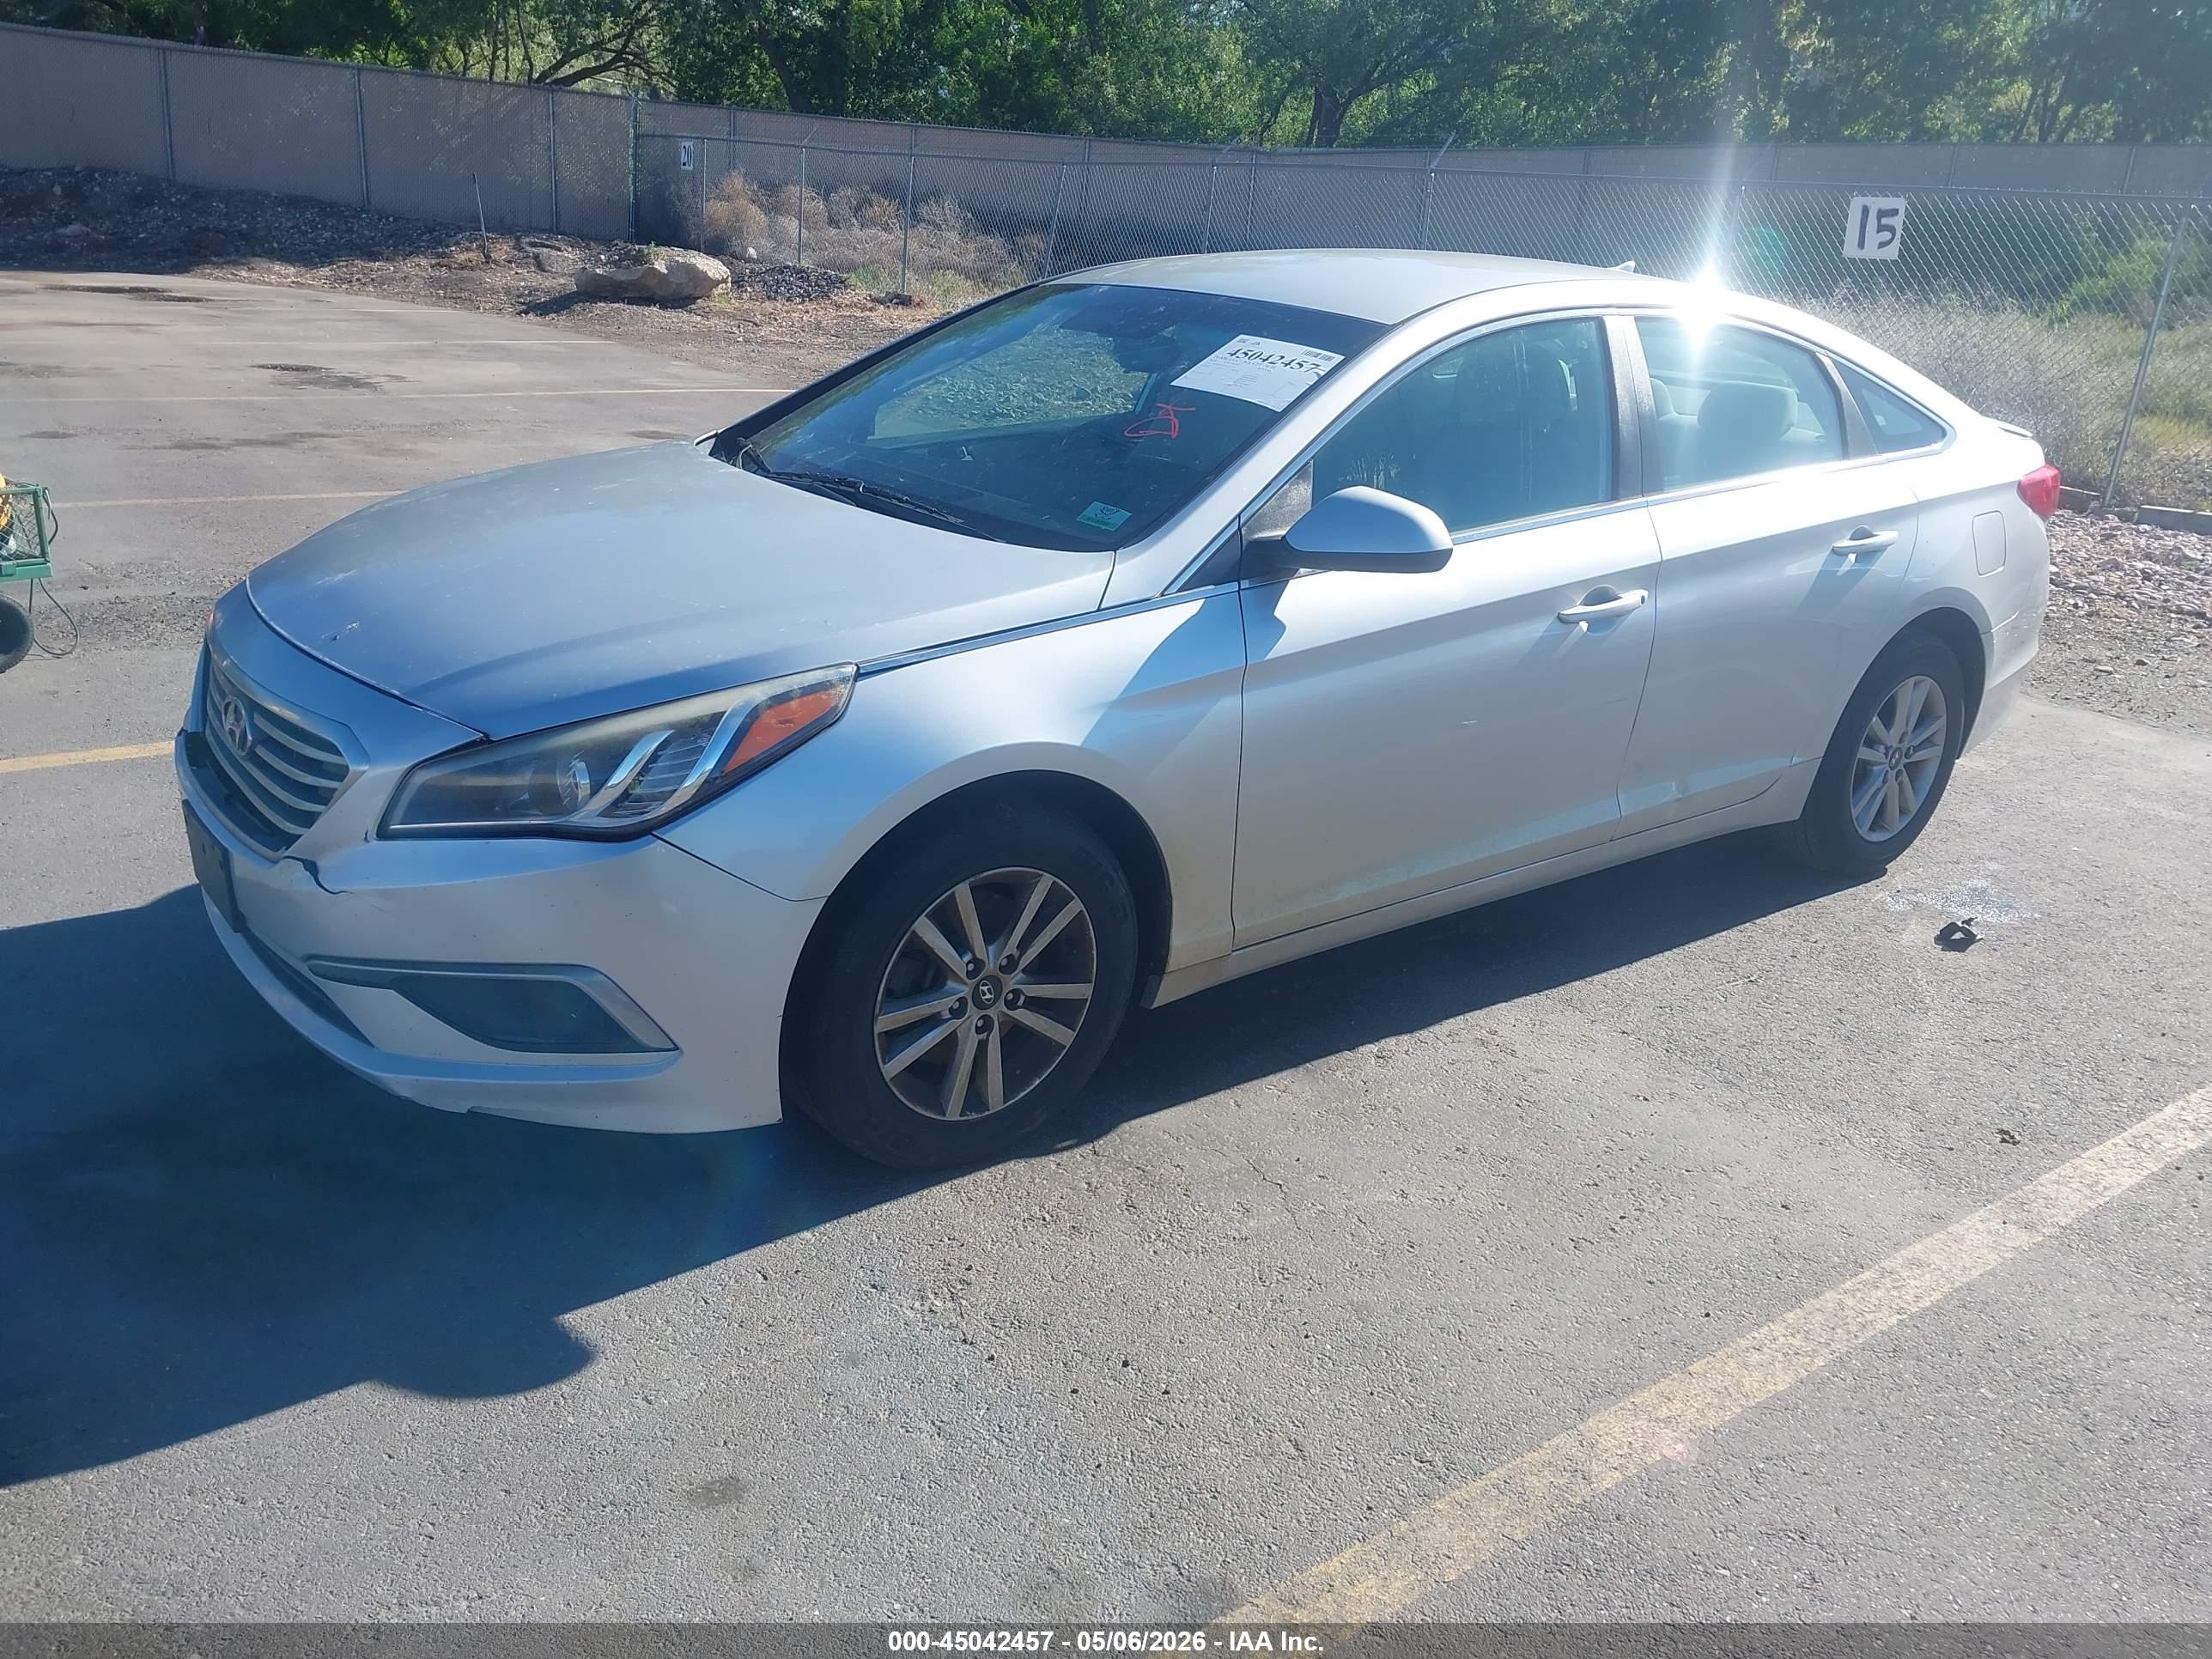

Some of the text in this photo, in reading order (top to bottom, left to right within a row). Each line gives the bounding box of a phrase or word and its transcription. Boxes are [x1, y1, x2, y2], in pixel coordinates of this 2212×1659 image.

[682, 144, 692, 167] 20
[1857, 204, 1899, 251] 15
[1226, 348, 1322, 374] 45042457
